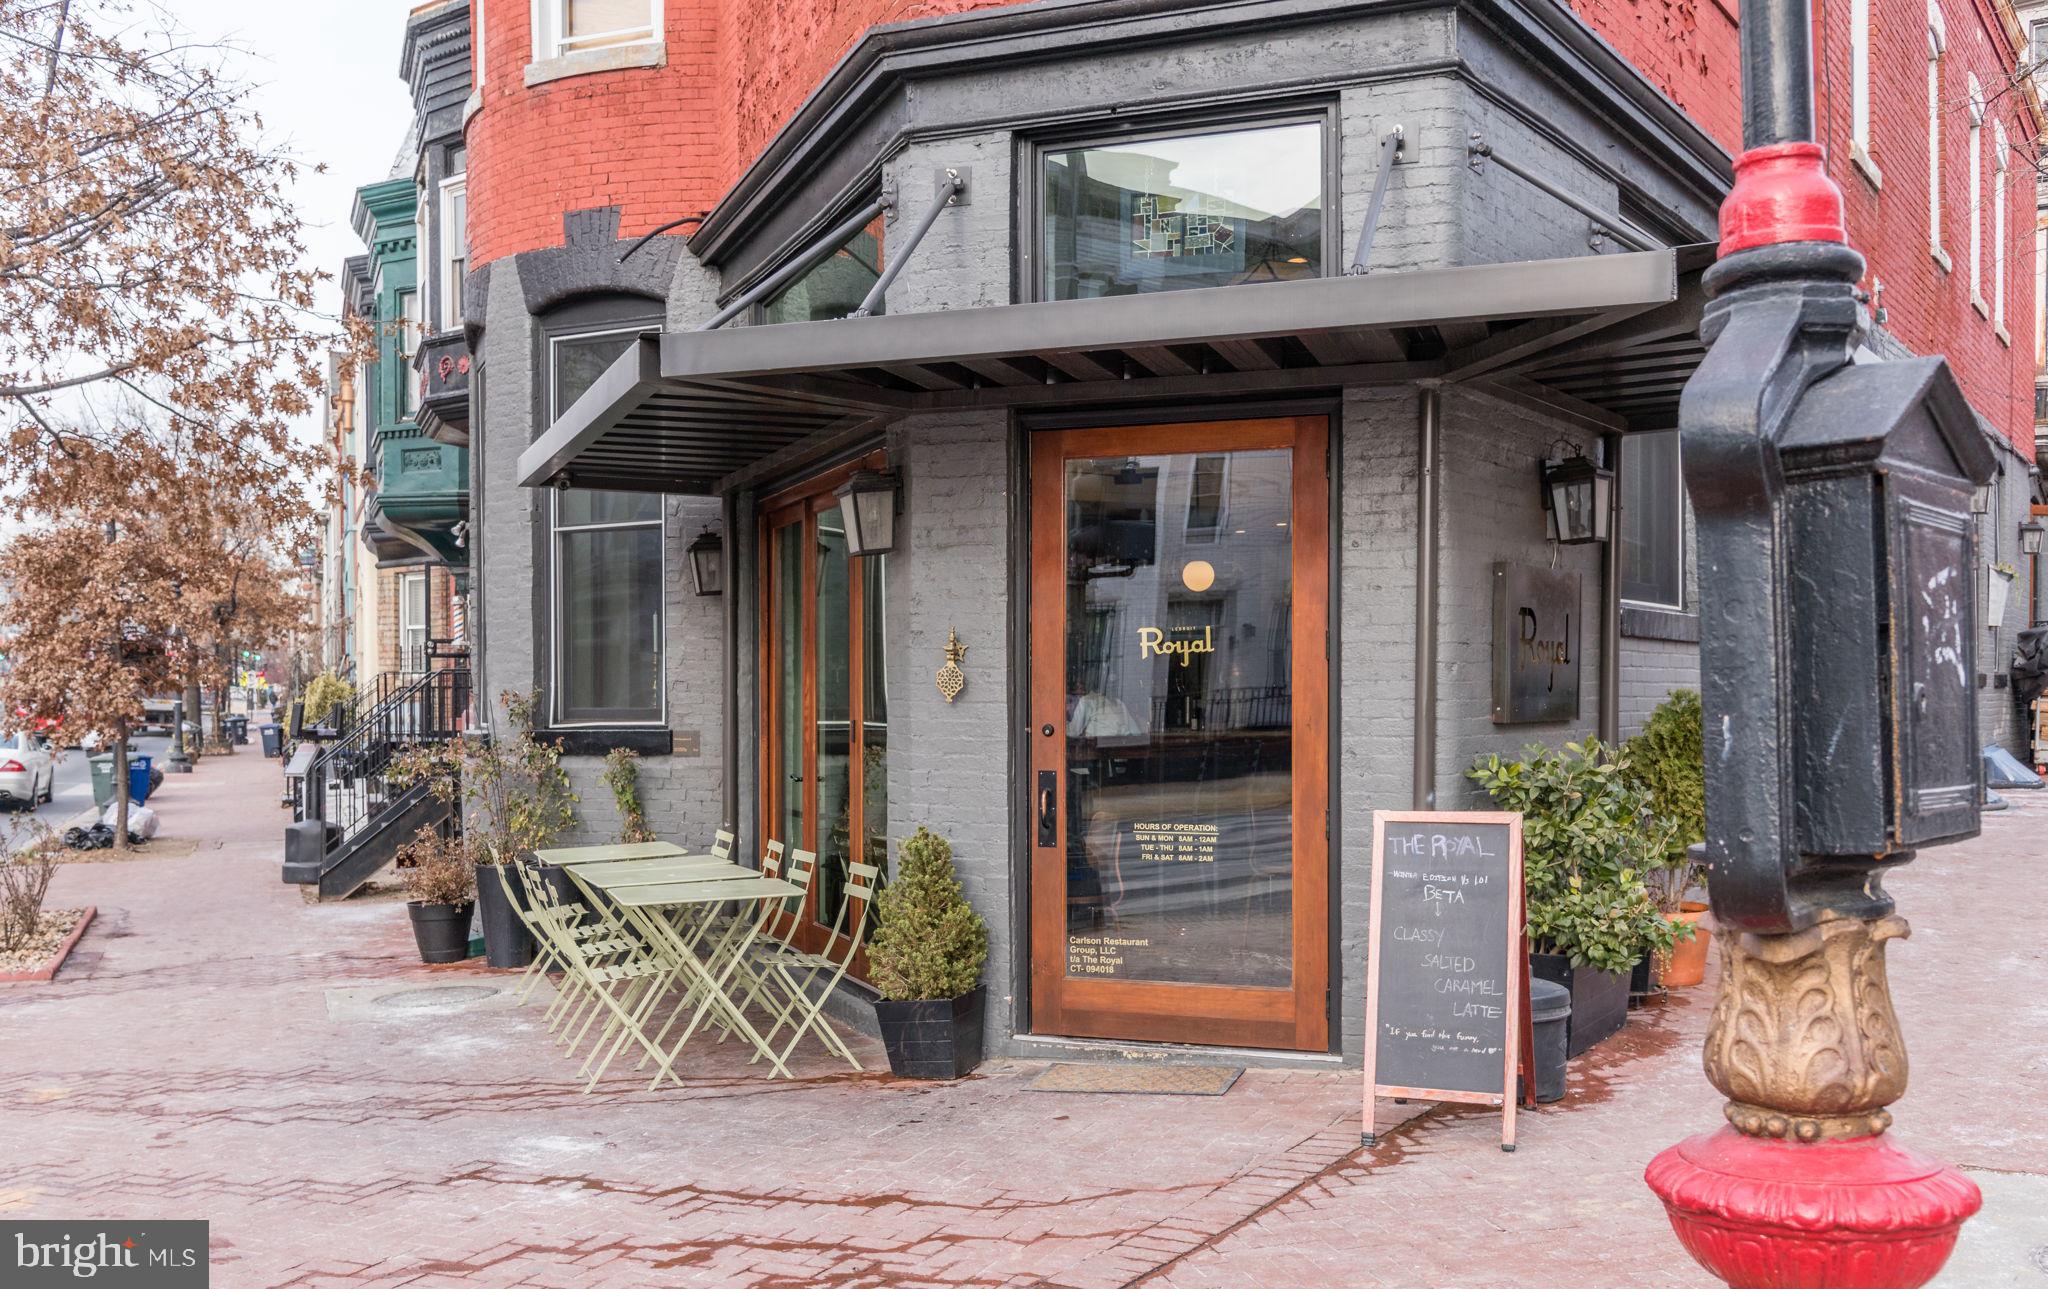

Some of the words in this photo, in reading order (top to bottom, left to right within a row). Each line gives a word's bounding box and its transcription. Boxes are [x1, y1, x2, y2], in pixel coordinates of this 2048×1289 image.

[1136, 625, 1215, 668] Royal
[1518, 606, 1571, 693] Royal
[1173, 823, 1218, 832] OPERATION:
[1388, 834, 1426, 856] THE
[1431, 834, 1496, 860] ROYAL
[1423, 884, 1465, 905] BETA
[1069, 936, 1101, 944] Carlson
[1103, 937, 1149, 946] Restaurant
[1393, 926, 1445, 948] CLASSY
[1069, 945, 1098, 955] Group,
[1100, 946, 1116, 955] LLC
[1082, 955, 1097, 963] The
[1100, 956, 1123, 965] Royal
[1086, 965, 1114, 973] 094018
[1421, 953, 1476, 973] SALTED
[1433, 978, 1504, 996] CARAMEL
[1453, 1001, 1503, 1019] LATTE
